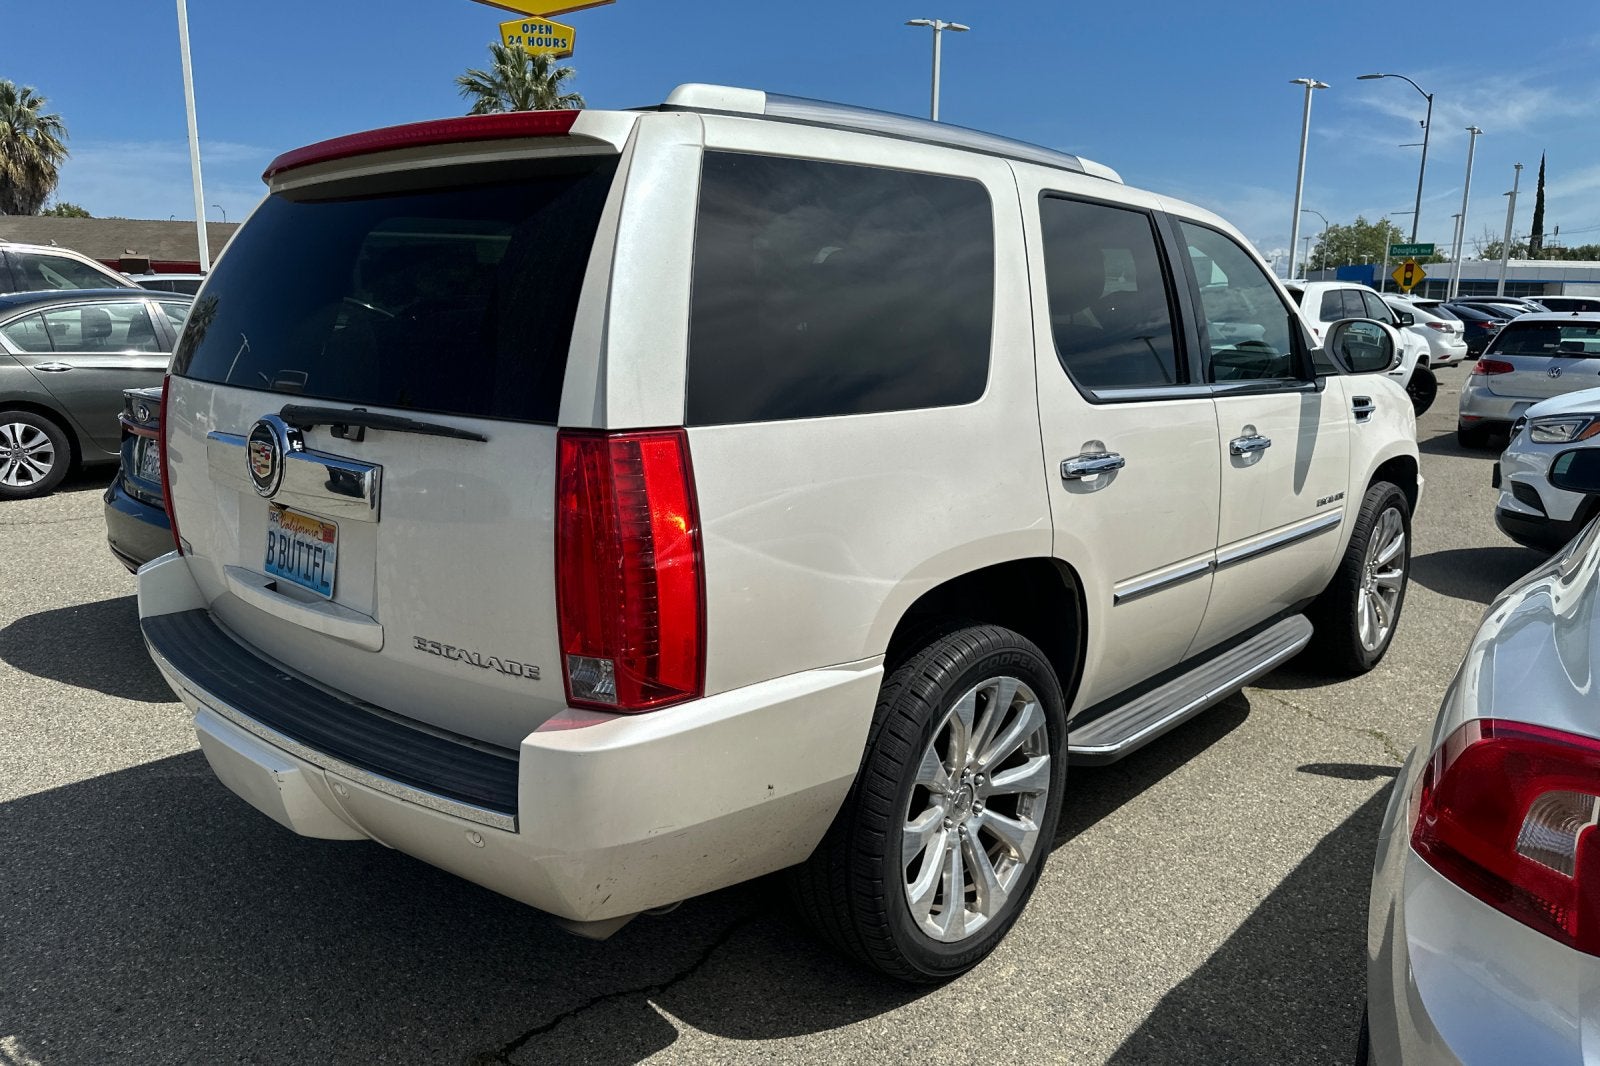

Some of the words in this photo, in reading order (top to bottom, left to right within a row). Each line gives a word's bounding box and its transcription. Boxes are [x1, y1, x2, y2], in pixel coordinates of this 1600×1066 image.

[522, 23, 552, 35] OPEN
[508, 35, 522, 45] 24
[528, 36, 567, 48] HOURS
[1393, 247, 1418, 255] Douglas
[280, 512, 319, 538] California
[266, 531, 275, 565] B
[278, 535, 330, 587] BUTIFL
[413, 635, 541, 680] ESCALADE
[979, 653, 1039, 672] COOPER
